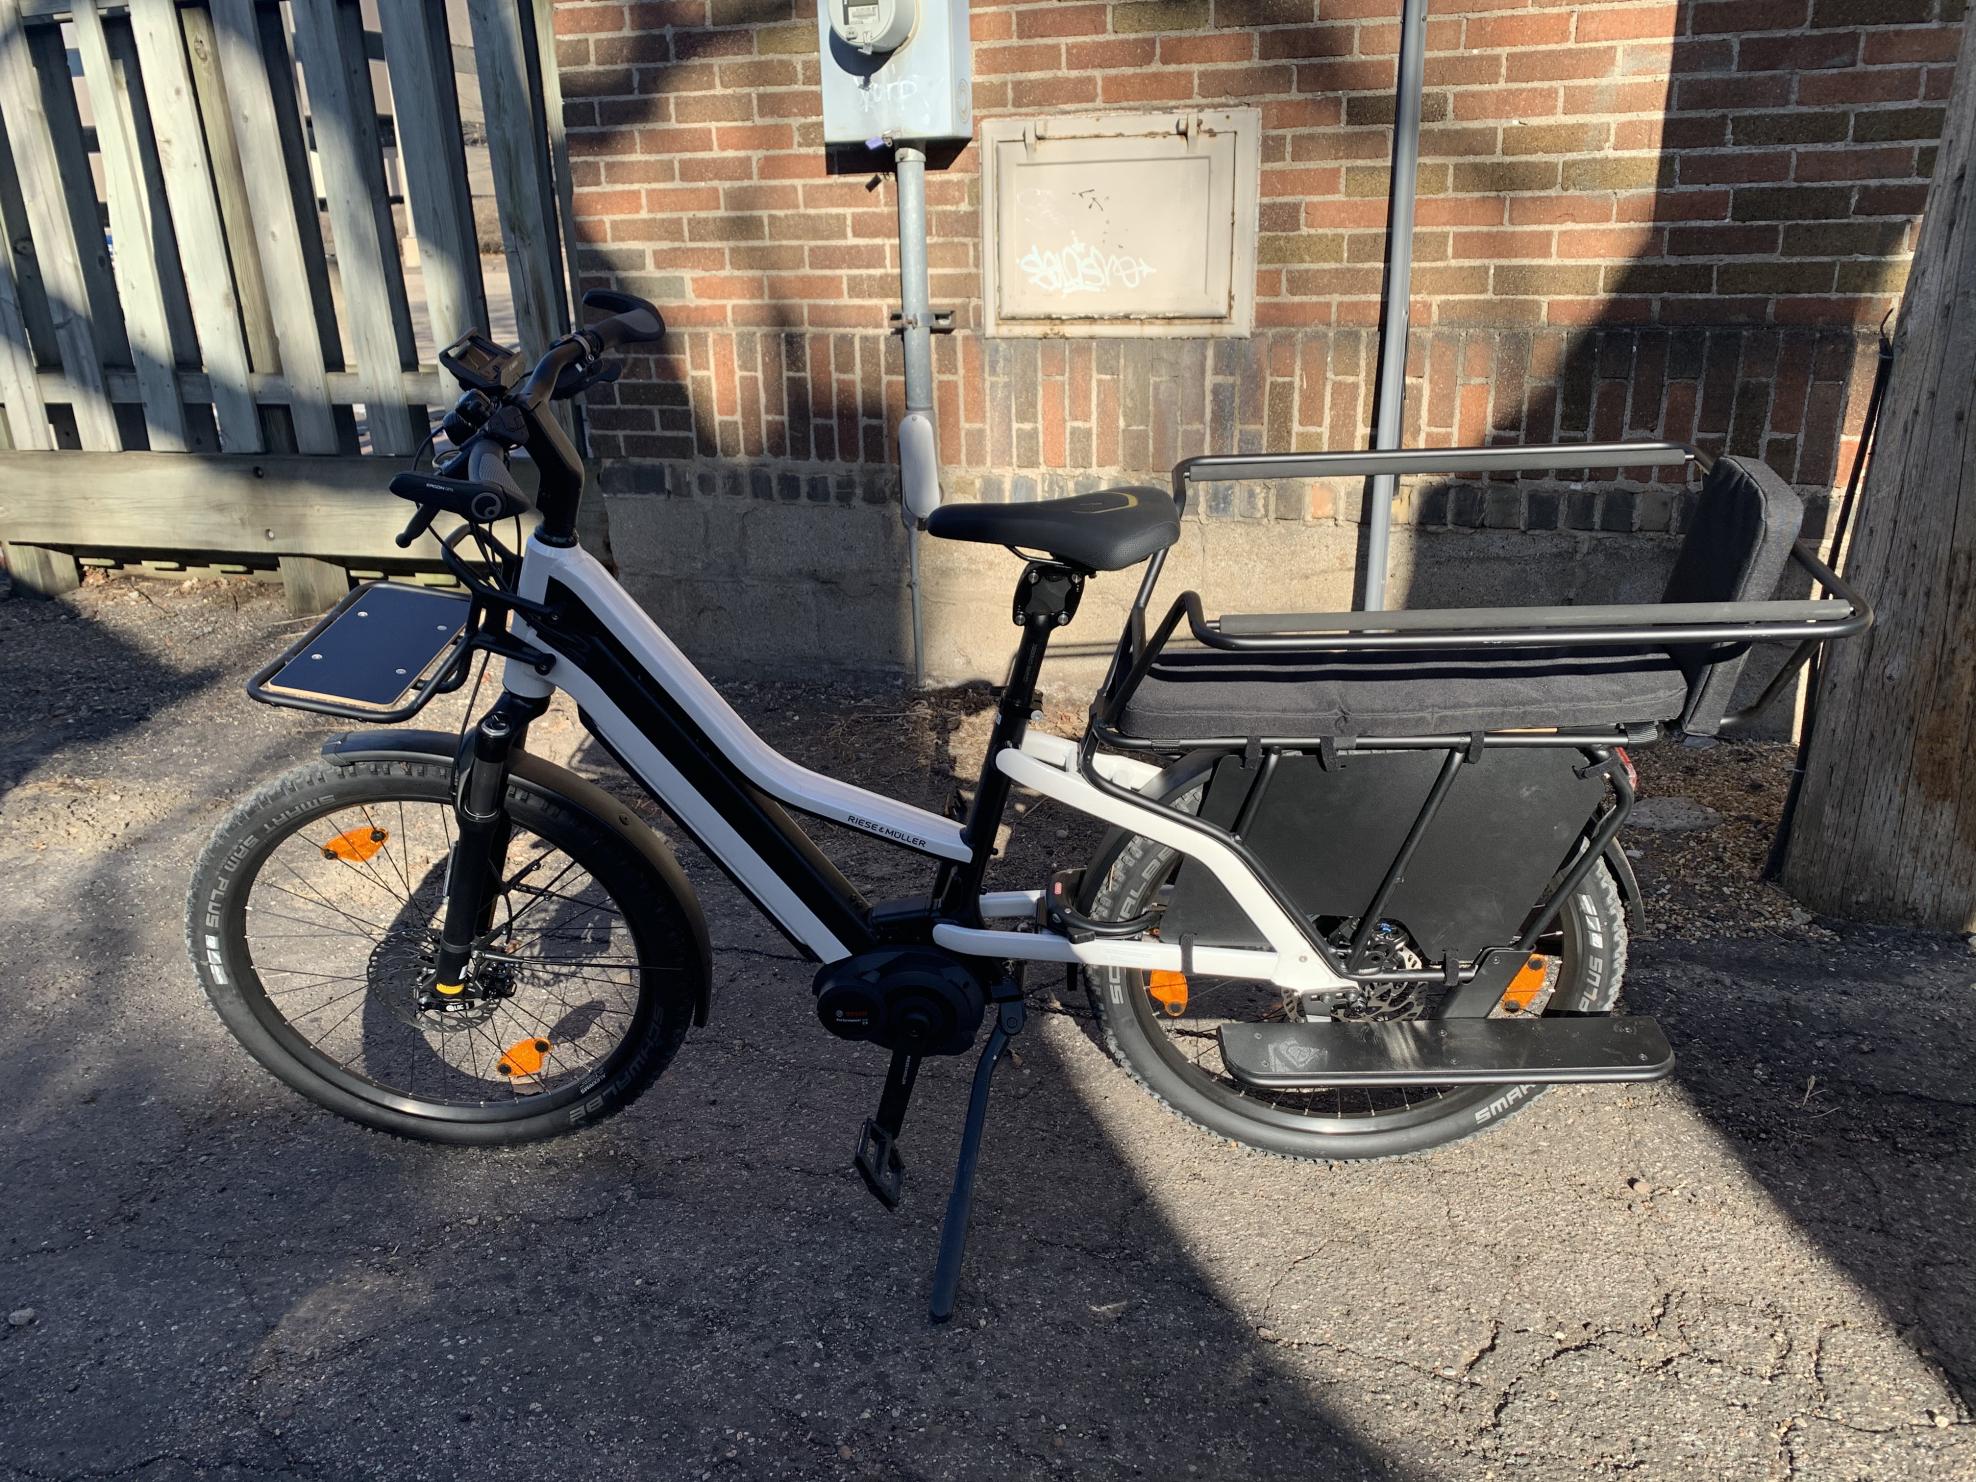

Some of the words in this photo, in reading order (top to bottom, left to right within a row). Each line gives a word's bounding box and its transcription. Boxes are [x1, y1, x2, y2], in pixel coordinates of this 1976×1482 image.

[263, 794, 336, 834] SMART
[223, 834, 260, 873] SAM
[205, 876, 230, 928] PLUS
[1475, 1084, 1537, 1124] SMAR
